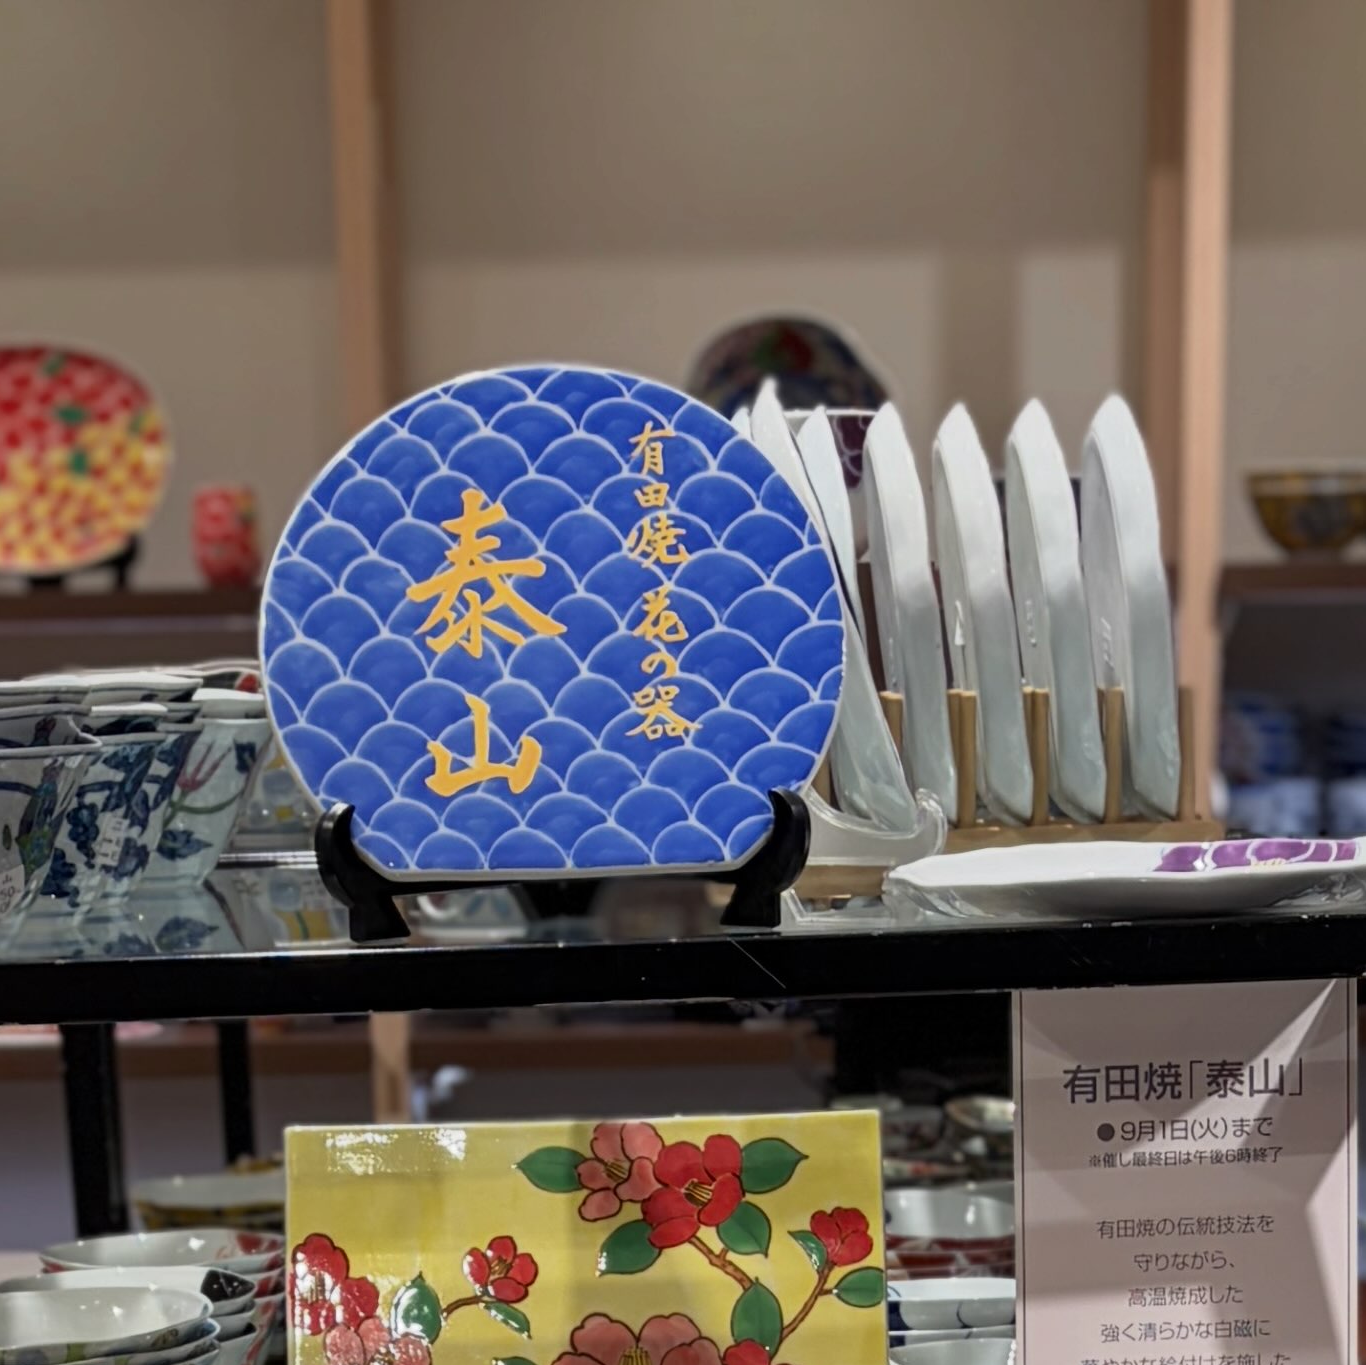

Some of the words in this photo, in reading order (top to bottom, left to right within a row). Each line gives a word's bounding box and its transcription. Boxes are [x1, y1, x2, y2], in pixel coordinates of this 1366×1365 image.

[407, 489, 567, 798] 泰山
[1063, 1057, 1304, 1105] 有田焼「泰山」
[1096, 1214, 1275, 1240] 有田焼の伝統技法を
[1133, 1249, 1235, 1273] 守りながら、
[1128, 1284, 1244, 1308] 高温焼成した
[1101, 1319, 1271, 1344] 強く清らかな白磁に
